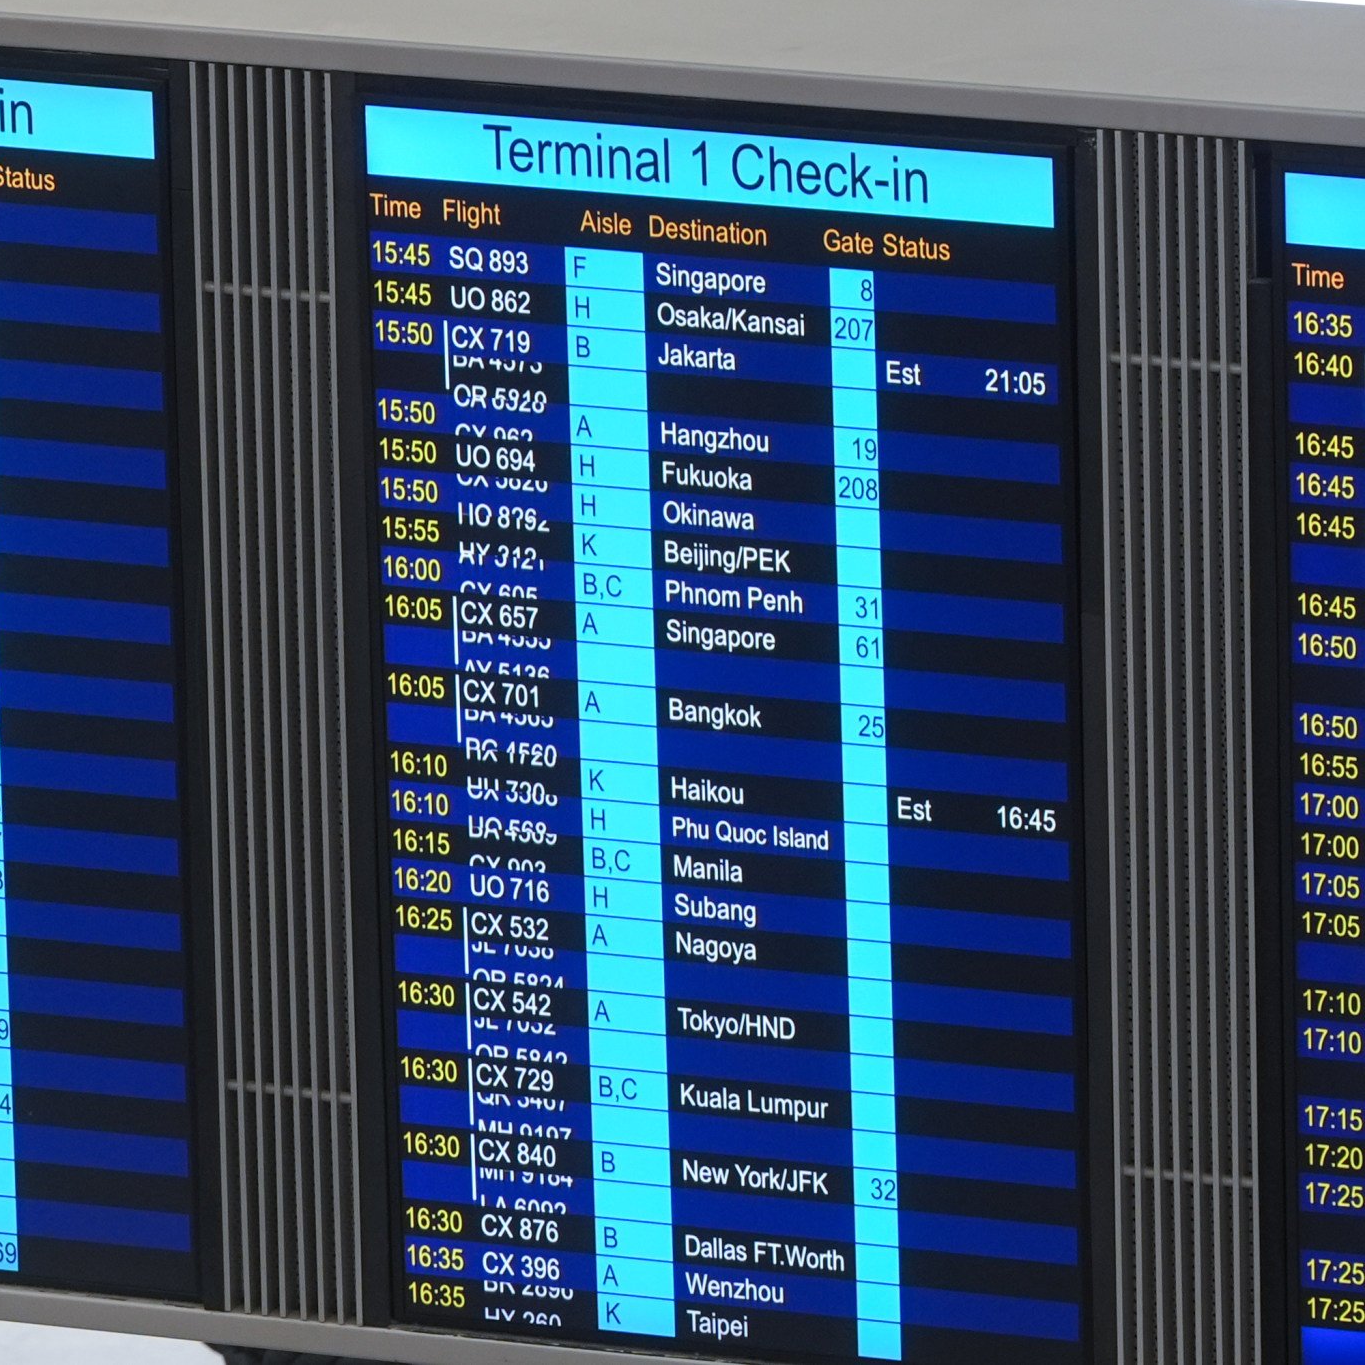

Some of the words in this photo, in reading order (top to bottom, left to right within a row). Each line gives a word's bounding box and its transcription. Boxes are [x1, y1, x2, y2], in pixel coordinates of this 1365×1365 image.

[481, 123, 671, 185] Terminal
[691, 139, 708, 187] 1
[731, 142, 929, 205] Check-in
[368, 192, 423, 220] Time
[442, 197, 502, 230] Flight
[579, 209, 633, 237] Aisle
[648, 213, 768, 247] Destination
[822, 227, 875, 256] Gate
[882, 232, 952, 262] Status
[1291, 262, 1345, 290] Time
[373, 278, 432, 307] 15:45
[449, 284, 487, 312] UO
[490, 288, 532, 315] 862
[573, 294, 591, 320] H
[656, 301, 806, 338] Osaka/Kansai
[833, 315, 877, 342] 207
[1293, 311, 1353, 338] 16:35
[1294, 351, 1353, 378] 16:40
[664, 578, 742, 609] Phnom
[746, 585, 804, 614] Penh
[1300, 752, 1359, 780] 16:55
[671, 815, 711, 841] Phu
[714, 819, 768, 846] Quoc
[772, 824, 830, 852] Island
[394, 865, 452, 894] 16:20
[469, 872, 506, 900] UO
[509, 876, 551, 904] 716
[592, 884, 609, 910] H
[674, 892, 758, 929] Subang
[1301, 872, 1360, 899] 17:05
[1305, 1143, 1363, 1170] 17:20
[682, 1157, 731, 1186] New
[733, 1163, 830, 1196] York/JFK
[405, 1205, 464, 1234] 16:30
[480, 1213, 515, 1240] CX
[518, 1217, 560, 1244] 876
[602, 1225, 619, 1250] B
[684, 1233, 748, 1263] Dallas
[753, 1240, 846, 1273] FT.Worth
